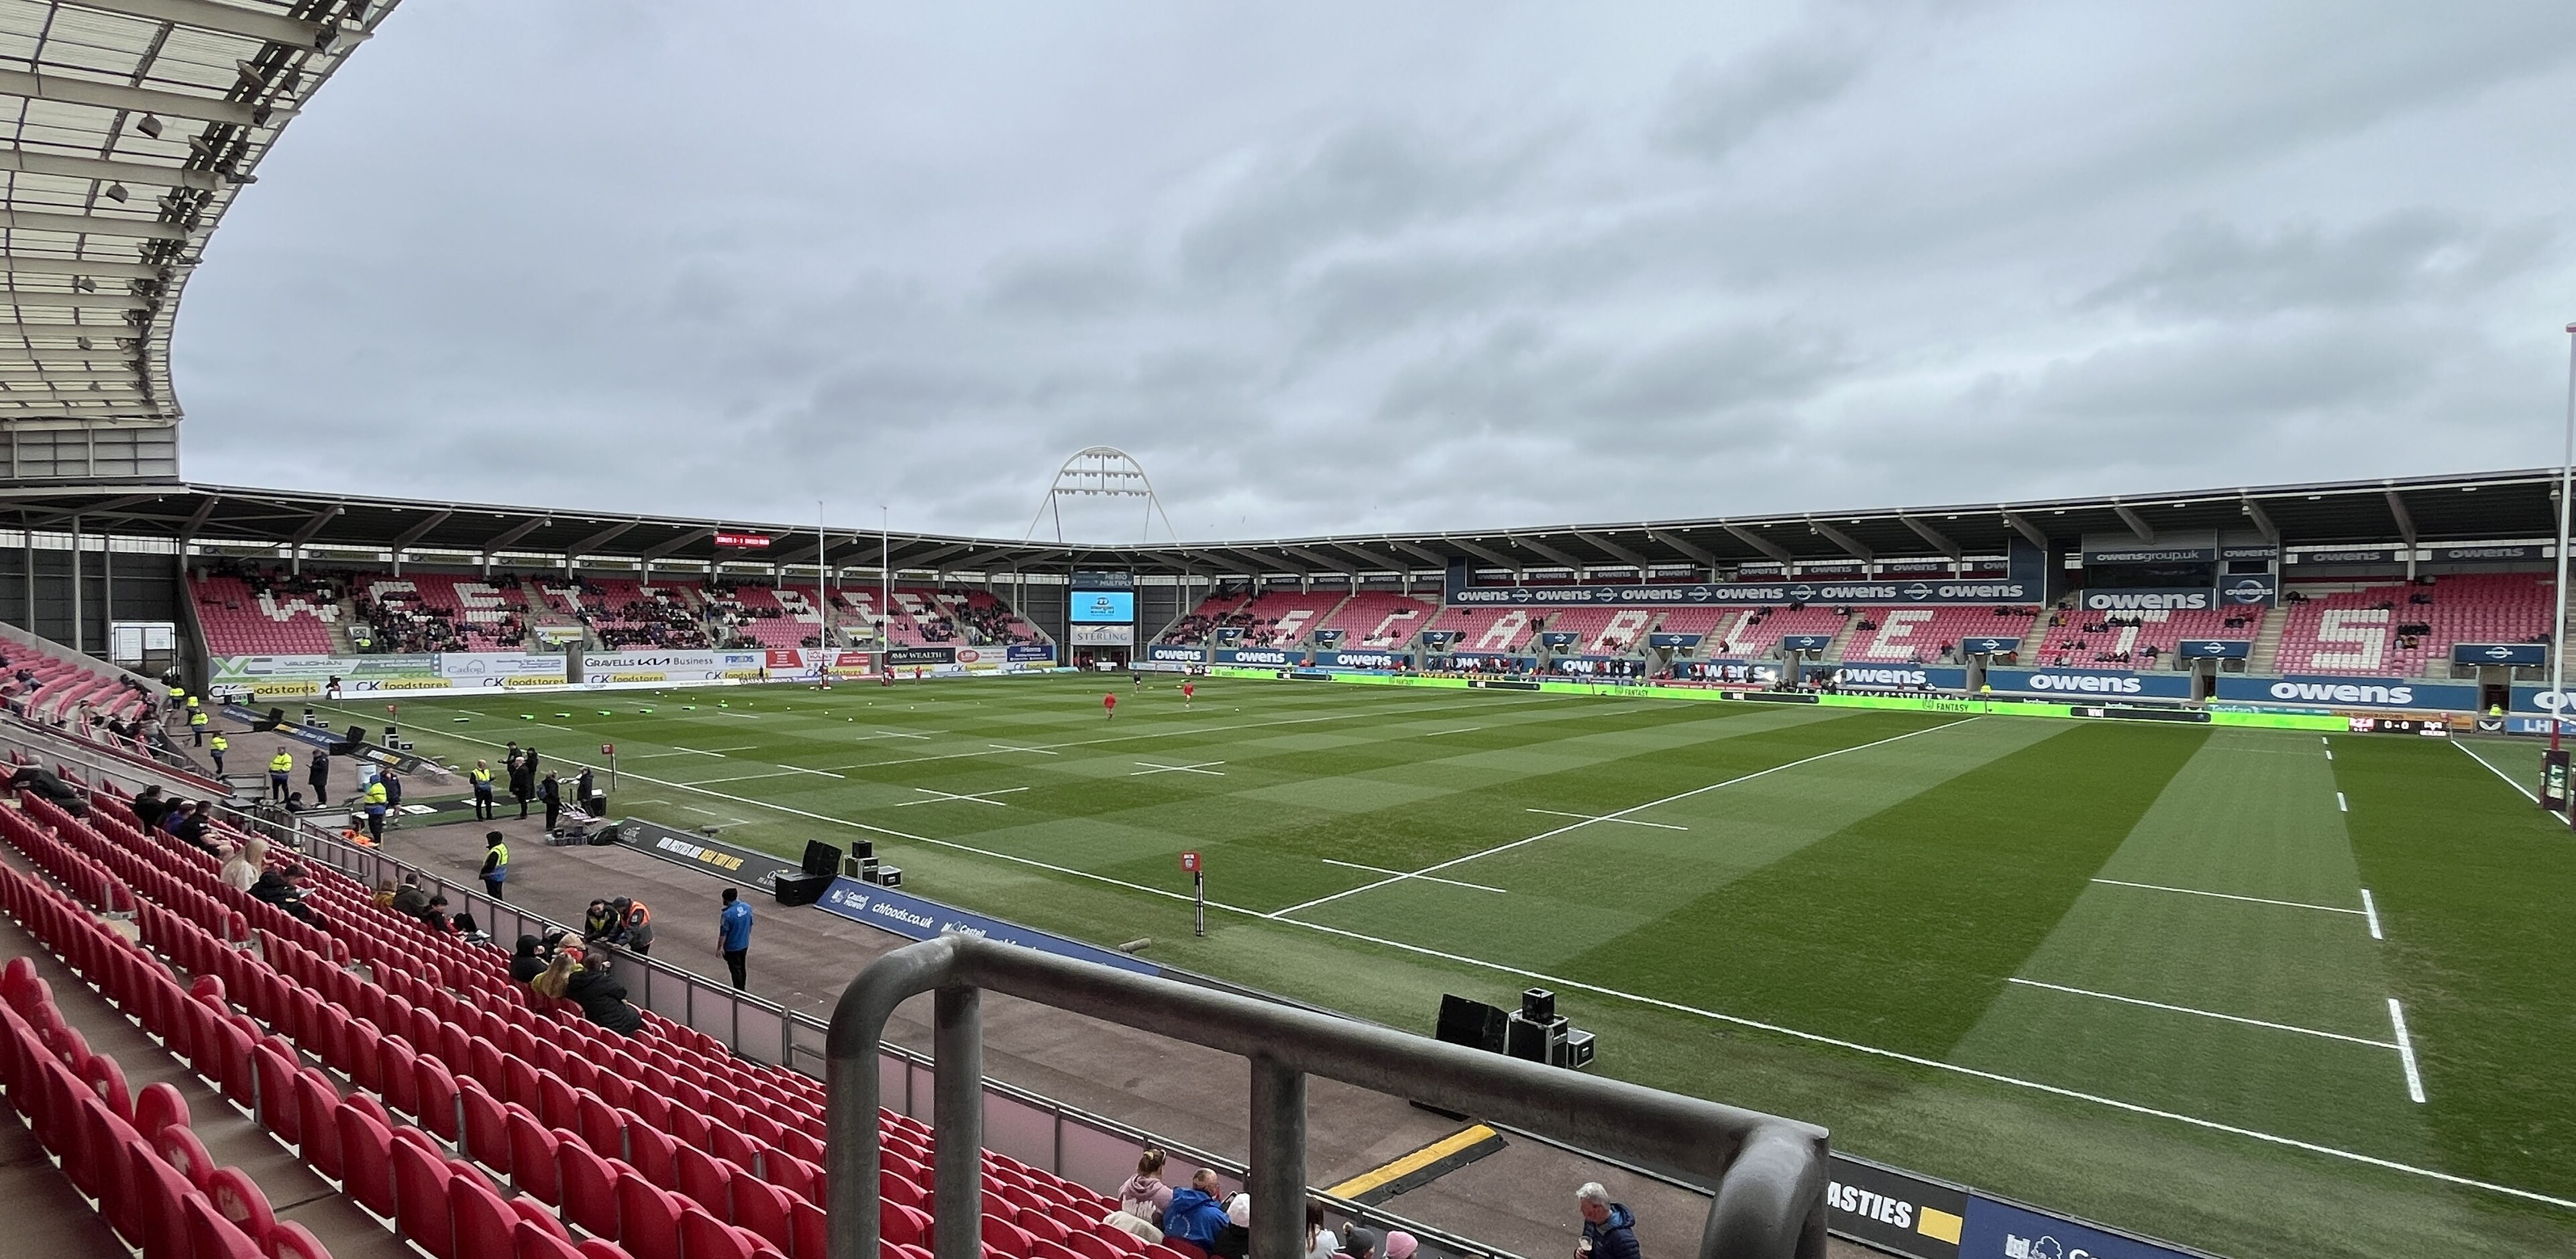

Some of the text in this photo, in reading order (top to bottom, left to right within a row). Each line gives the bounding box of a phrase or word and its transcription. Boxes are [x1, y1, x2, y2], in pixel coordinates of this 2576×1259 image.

[2096, 549, 2199, 562] owensgroup.uk
[2223, 548, 2277, 558] owens
[2312, 550, 2381, 562] owens
[2448, 547, 2525, 559] owens
[1811, 565, 1852, 573] owens
[1457, 590, 1509, 601] owens
[1536, 590, 1591, 601] owens
[1621, 588, 1682, 600] owens
[1716, 588, 1784, 599] owens
[1821, 586, 1896, 598] owens
[1939, 584, 2023, 598] owens
[2088, 593, 2206, 610] owens
[1078, 633, 1127, 641] STERLING
[725, 655, 754, 663] FREDS
[1155, 650, 1201, 660] owens
[1236, 651, 1285, 663] owens
[1337, 654, 1392, 666] owens
[585, 658, 635, 667] GRAVELLS
[674, 657, 713, 665] Business
[591, 673, 664, 683] CK foodstores
[706, 670, 769, 679] CK foodstors
[1835, 669, 1926, 684] owens
[356, 680, 449, 692] CK foodstores
[484, 677, 564, 687] CK foodstores
[2030, 674, 2141, 693] owens
[254, 684, 316, 695] odstores
[1625, 689, 1649, 697] FANTASY
[2270, 681, 2413, 704] owens
[1937, 703, 1968, 712] FANTASY
[847, 891, 870, 904] Castell
[872, 902, 934, 930] chfoods.co.uk
[1827, 1180, 1913, 1229] ASTIES
